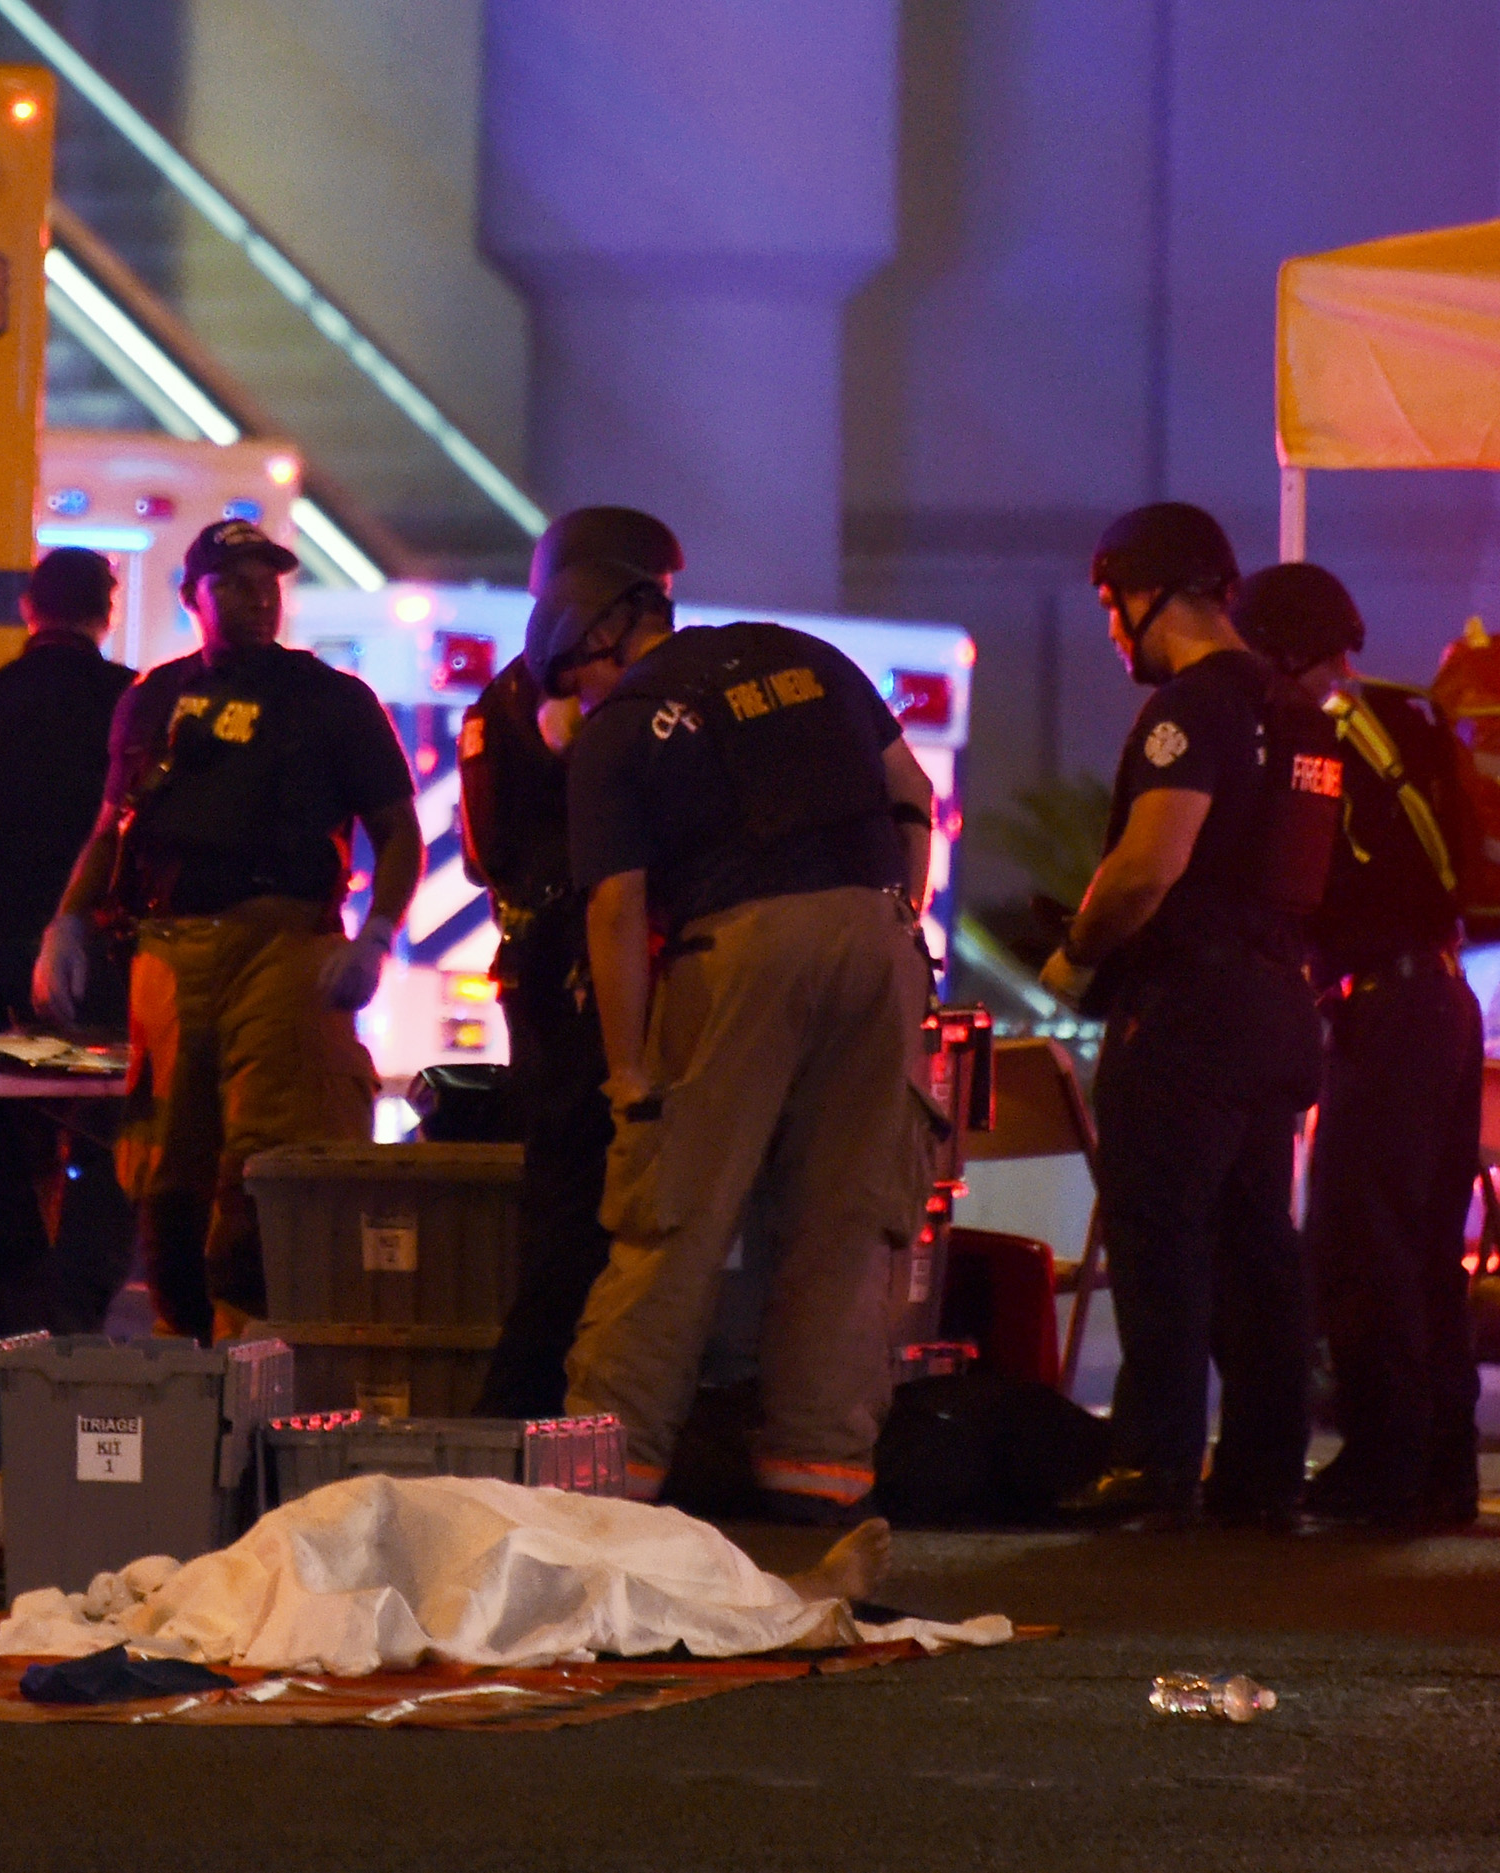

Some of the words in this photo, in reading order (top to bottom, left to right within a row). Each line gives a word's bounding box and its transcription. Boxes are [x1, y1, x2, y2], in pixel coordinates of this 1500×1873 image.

[81, 1416, 138, 1434] TRIAGE
[96, 1439, 121, 1456] KIT
[104, 1459, 115, 1474] 1
